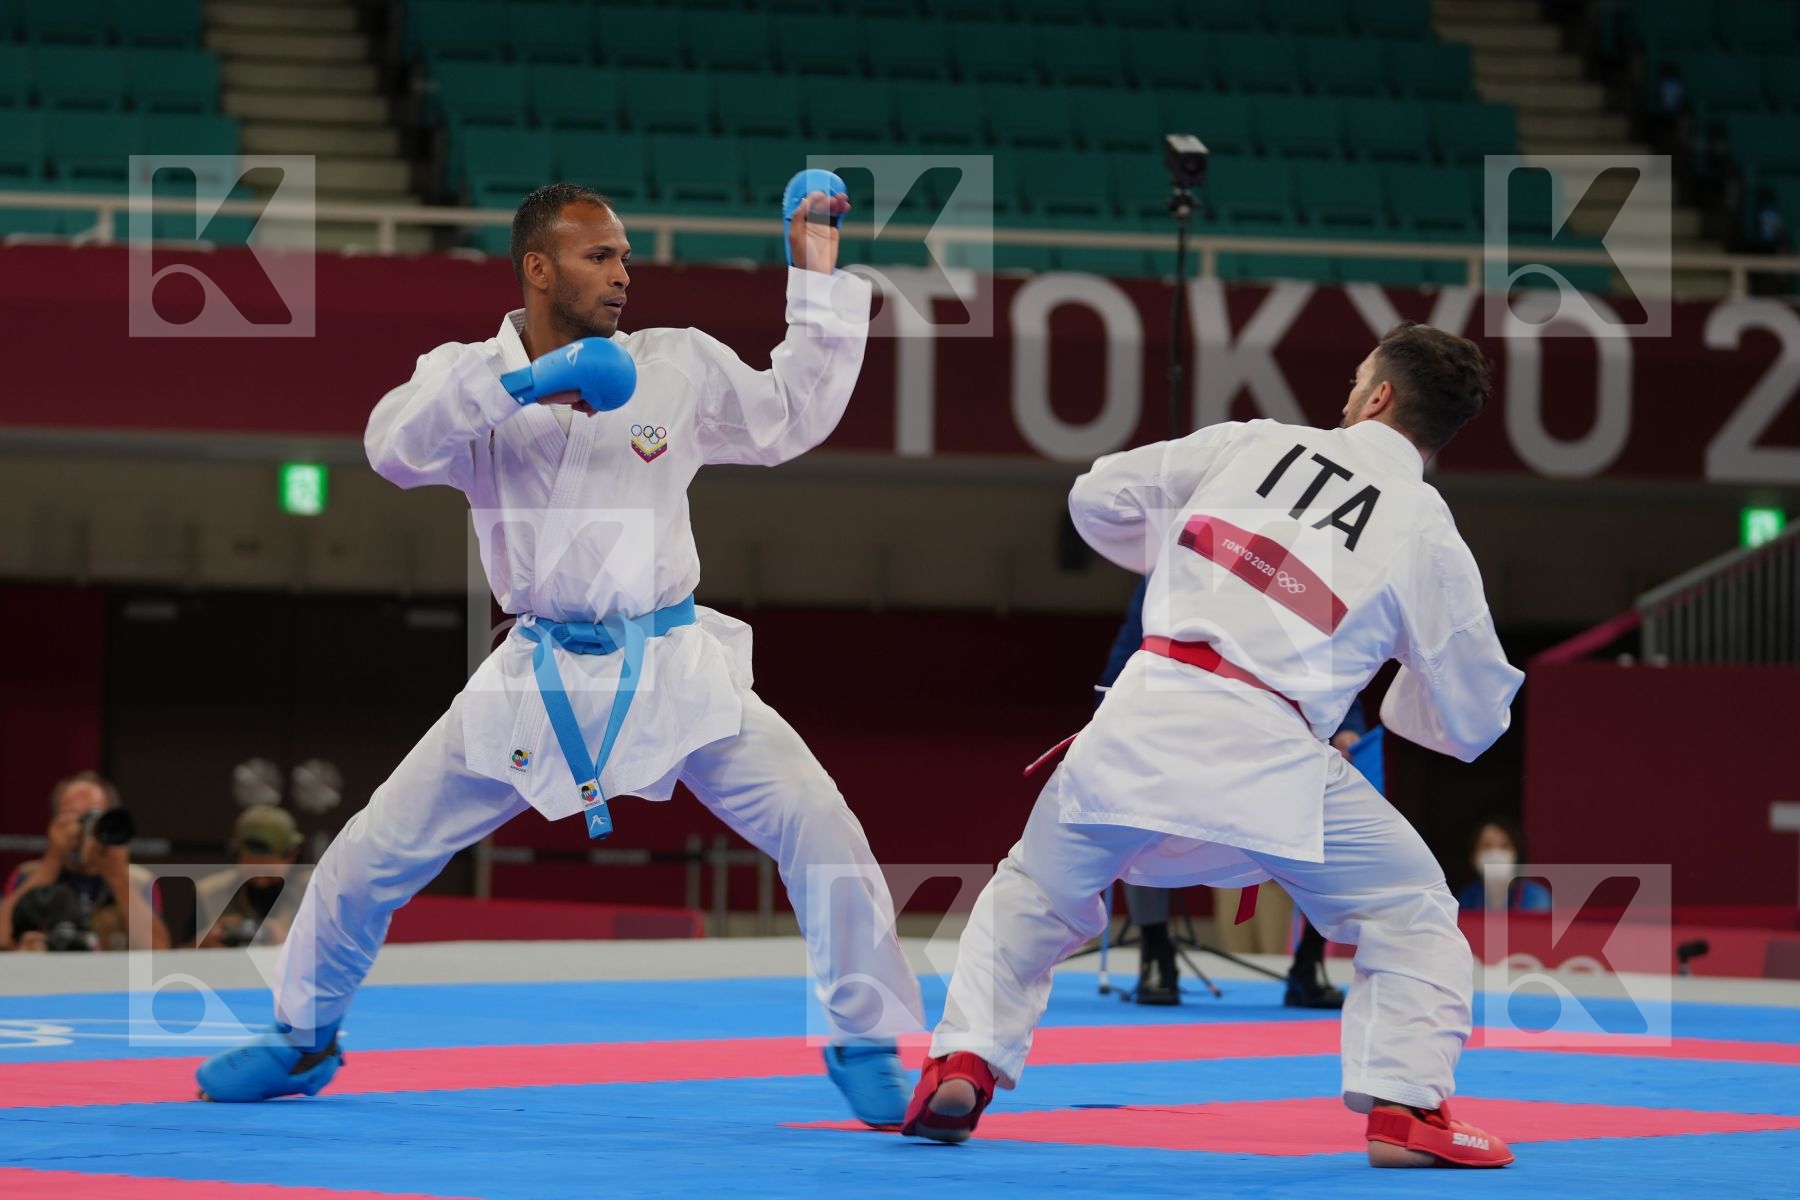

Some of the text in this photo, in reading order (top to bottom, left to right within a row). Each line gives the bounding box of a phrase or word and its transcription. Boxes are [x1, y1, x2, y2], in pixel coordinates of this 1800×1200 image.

[1256, 443, 1381, 552] ITA
[1222, 538, 1276, 577] TOKYO 2020
[1452, 1132, 1489, 1150] SMAI
